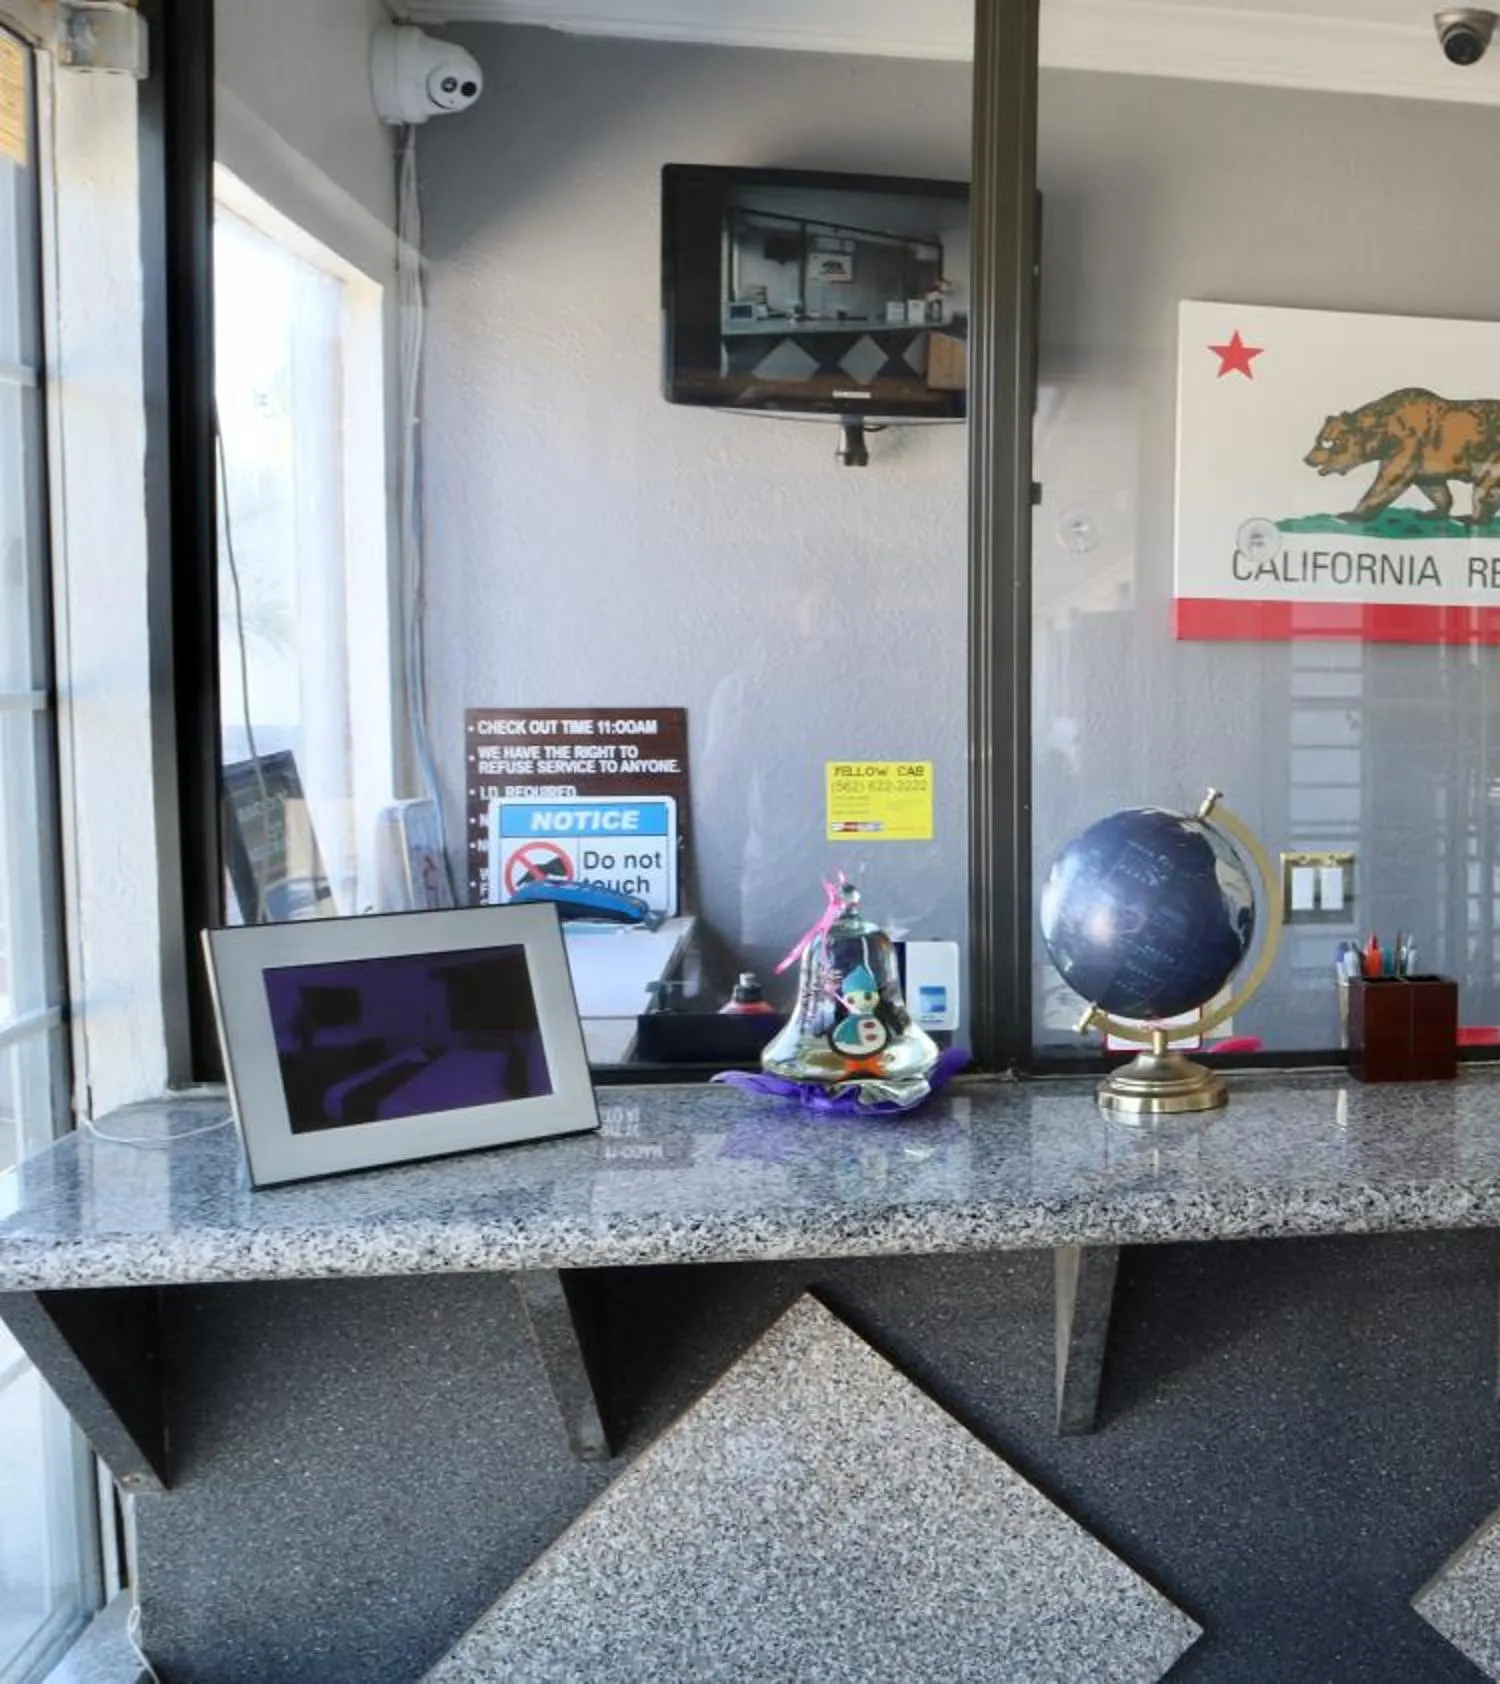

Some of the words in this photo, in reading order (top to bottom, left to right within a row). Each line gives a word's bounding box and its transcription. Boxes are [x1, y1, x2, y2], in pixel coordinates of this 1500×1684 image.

[1232, 549, 1441, 587] CALIFORNIA
[477, 720, 527, 735] CHECK
[529, 720, 557, 735] OUT
[563, 719, 594, 735] TIME
[597, 719, 659, 735] 11:00AM
[478, 746, 501, 759] WE
[503, 746, 541, 759] HAVE
[544, 746, 572, 759] THE
[574, 745, 617, 759] RIGHT
[620, 745, 639, 759] TO
[479, 760, 534, 774] REFUSE
[537, 760, 597, 774] SERVICE
[600, 760, 618, 773] TO
[530, 810, 641, 832] NOTICE
[583, 851, 616, 869] Do
[624, 852, 663, 869] not
